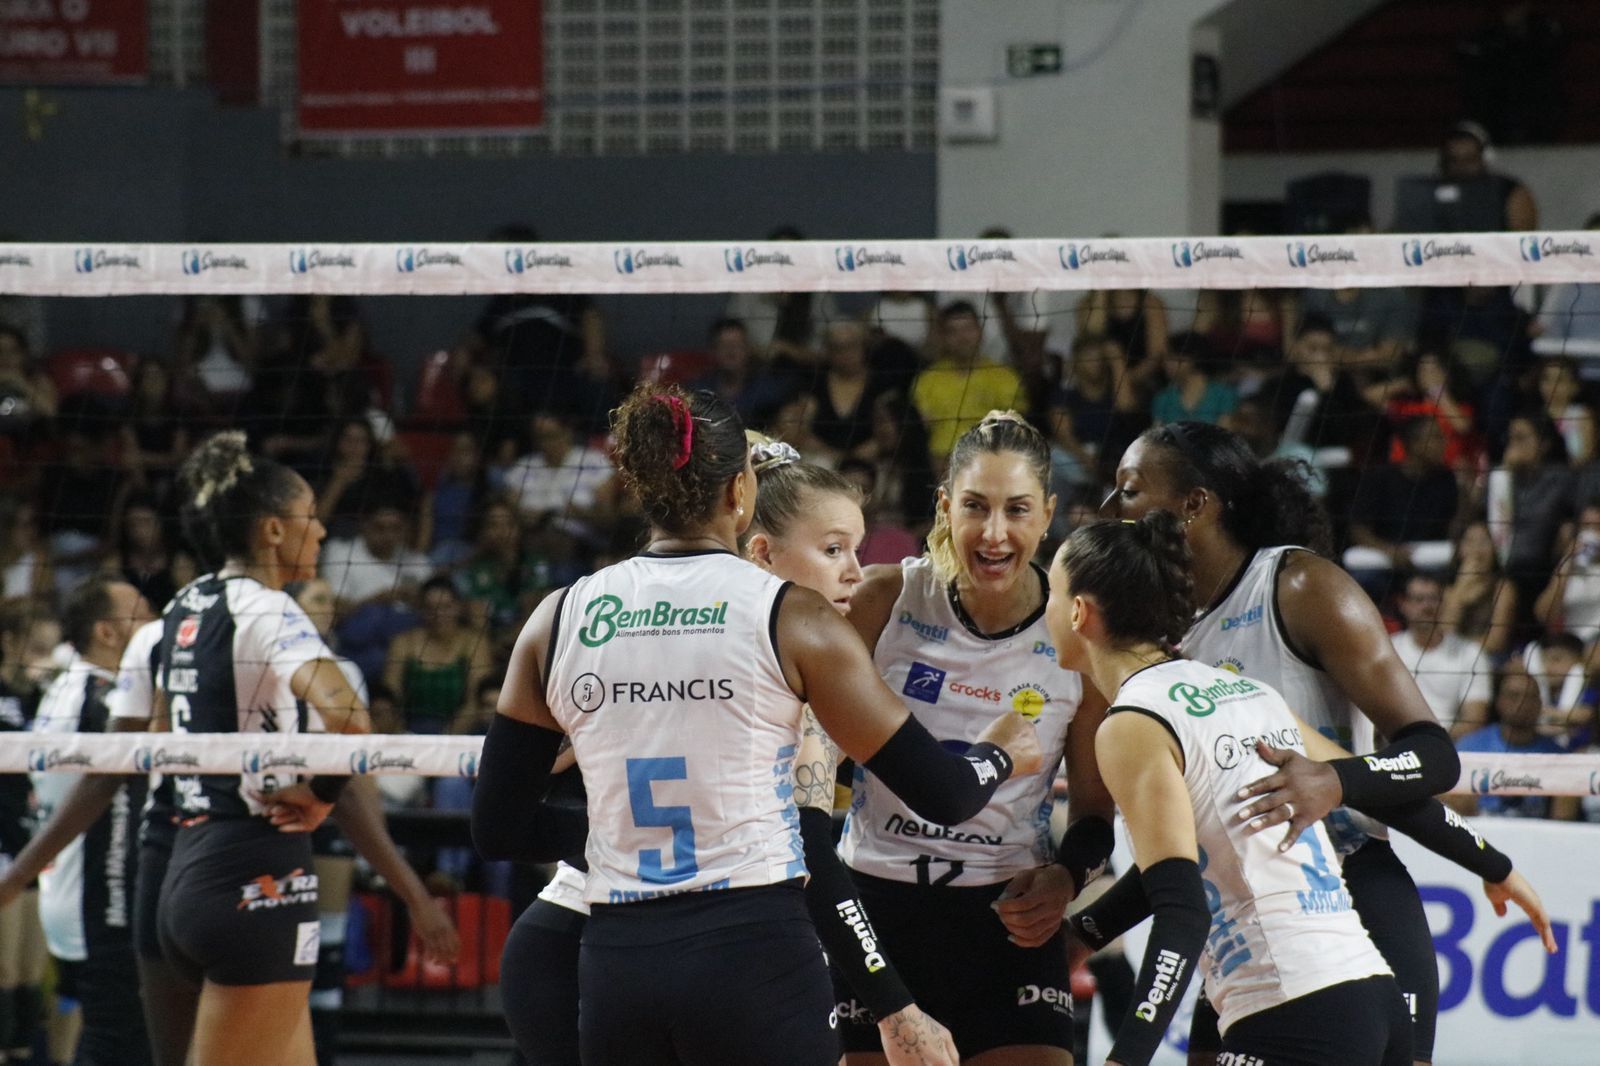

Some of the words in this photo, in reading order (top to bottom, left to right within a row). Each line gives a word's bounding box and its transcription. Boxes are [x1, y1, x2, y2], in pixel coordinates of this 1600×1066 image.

[340, 8, 500, 37] VOLEIBOL
[662, 628, 681, 637] bons
[683, 627, 725, 636] momentos
[898, 610, 950, 641] Dentil
[613, 679, 734, 703] FRANCIS
[949, 681, 1002, 701] crock's
[1364, 751, 1421, 772] Dentil
[626, 756, 698, 885] 5
[836, 899, 887, 973] Dentil
[1136, 949, 1181, 1023] Dentil
